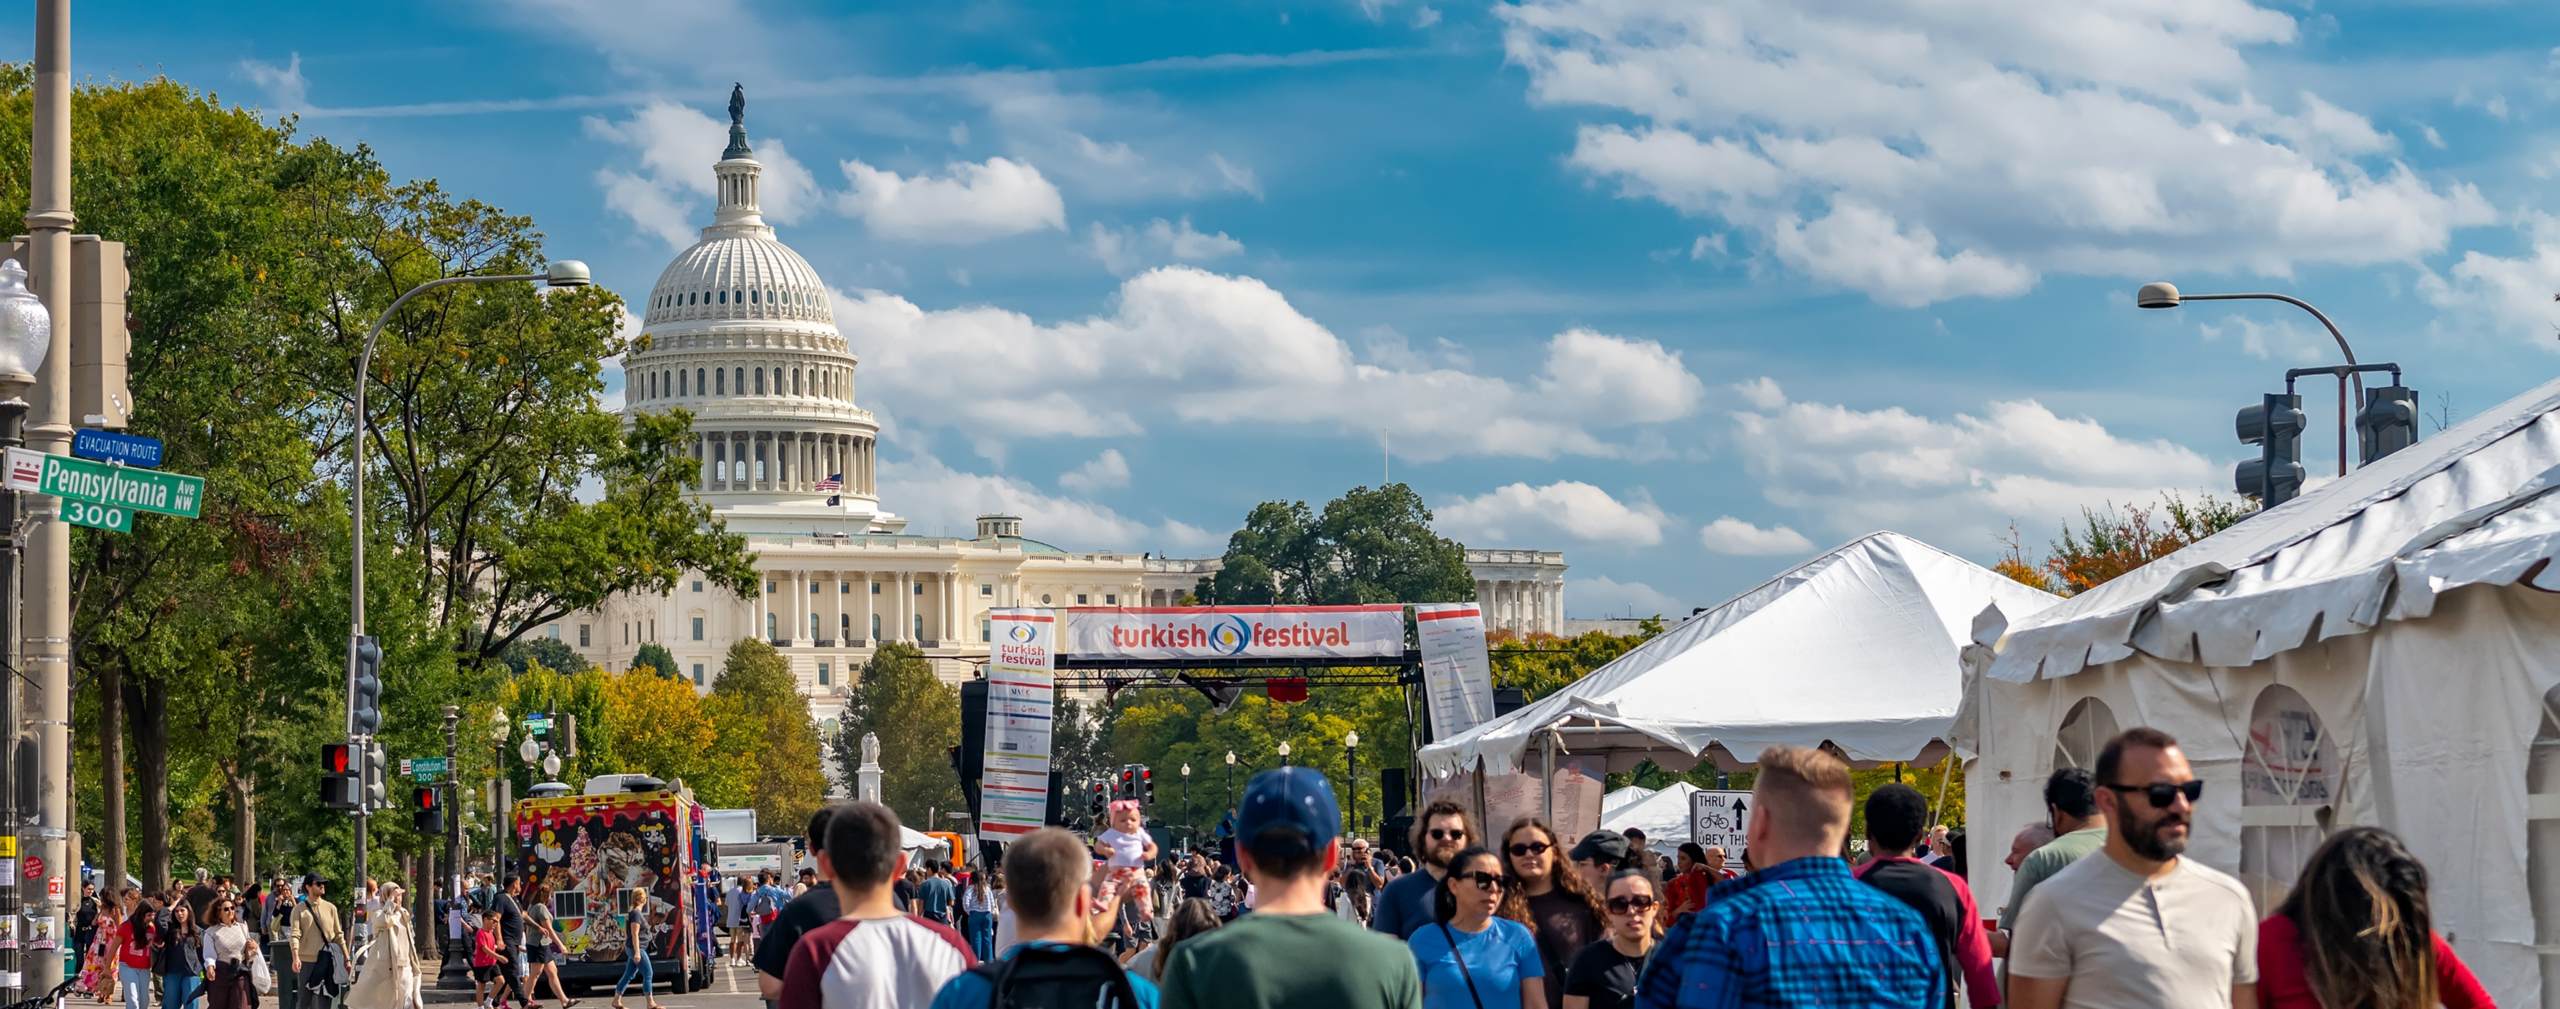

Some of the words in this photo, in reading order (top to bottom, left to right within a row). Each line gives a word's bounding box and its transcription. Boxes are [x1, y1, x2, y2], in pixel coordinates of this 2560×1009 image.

[79, 435, 130, 456] EVACUATION
[130, 443, 158, 461] ROUTE
[45, 459, 167, 508] Pennsylvania
[177, 479, 195, 495] Ave
[174, 495, 193, 511] NW
[68, 502, 122, 528] 300
[1112, 622, 1207, 648] turkish
[1253, 621, 1350, 647] festival
[1001, 643, 1045, 656] turkish
[1001, 652, 1045, 666] festival
[412, 760, 442, 772] Constitution
[417, 773, 432, 782] 300
[1699, 795, 1726, 807] THRU
